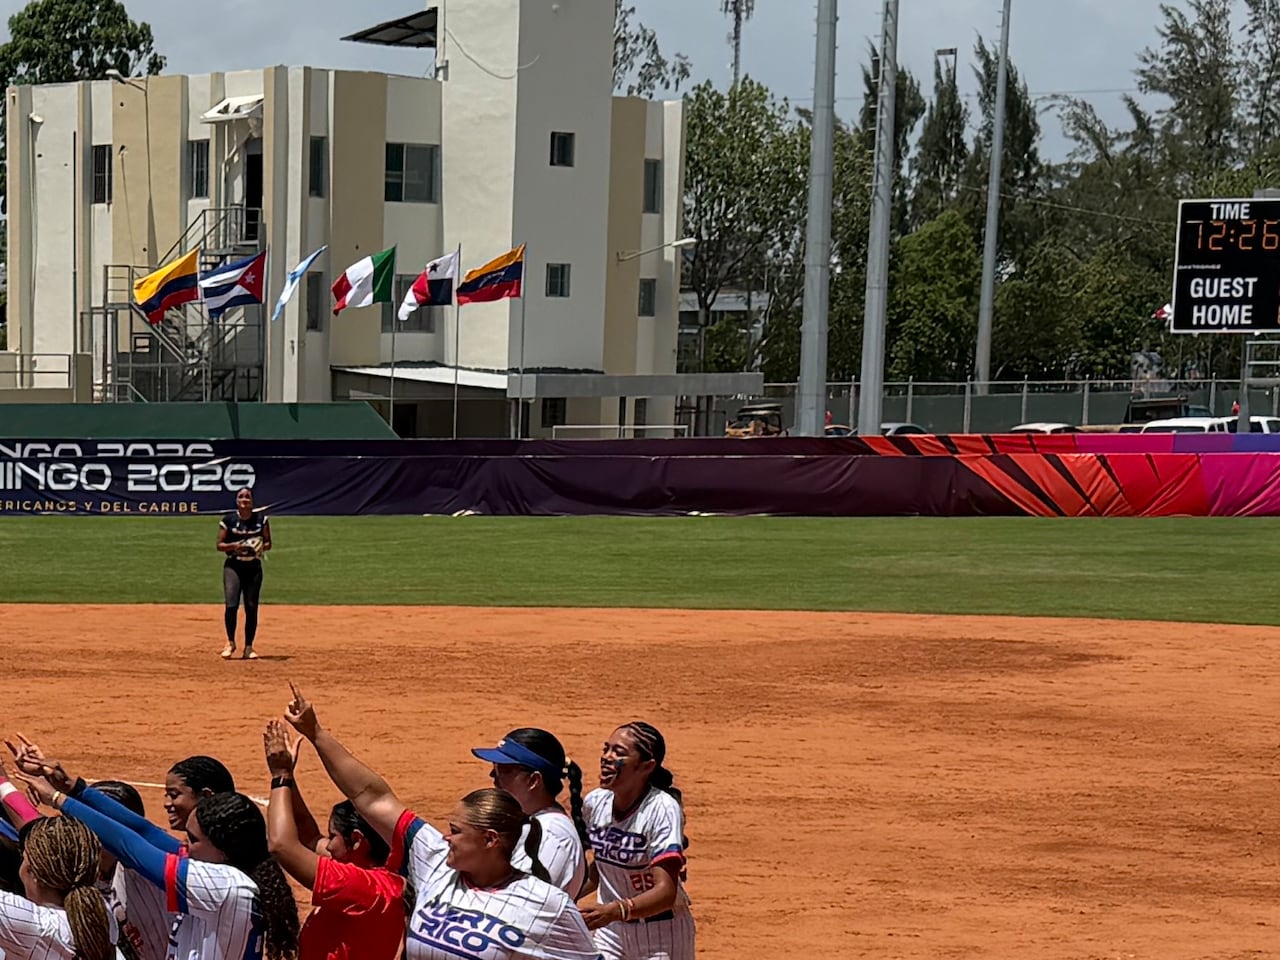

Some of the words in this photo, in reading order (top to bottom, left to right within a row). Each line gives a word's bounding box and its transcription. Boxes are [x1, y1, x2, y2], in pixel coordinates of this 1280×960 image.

[1209, 203, 1251, 220] TIME
[1189, 277, 1259, 298] GUEST
[1191, 304, 1254, 326] HOME
[126, 462, 257, 492] 2026
[85, 502, 94, 513] Y
[100, 502, 131, 513] DEL
[138, 502, 198, 513] CARIBE
[417, 909, 492, 952] RICO
